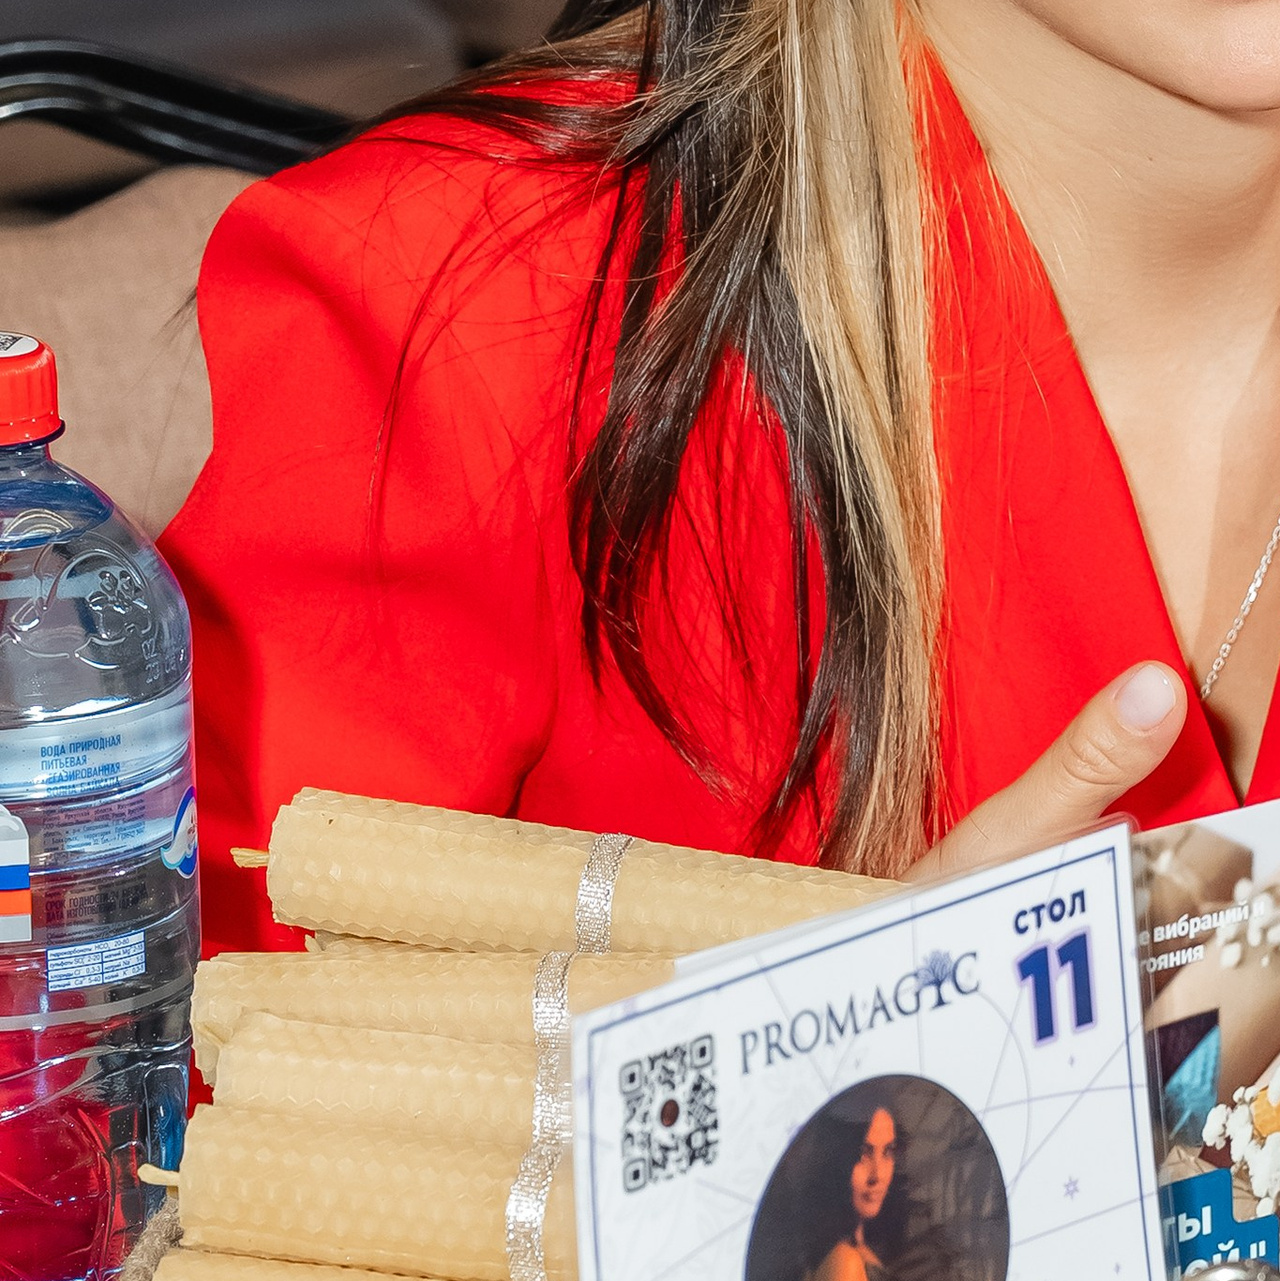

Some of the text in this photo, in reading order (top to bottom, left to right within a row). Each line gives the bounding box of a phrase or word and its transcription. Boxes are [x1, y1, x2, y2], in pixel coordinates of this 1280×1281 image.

[40, 734, 122, 758] ВОДА ПРИРОДНАЯ
[41, 755, 87, 771] ПИТЬЕВАЯ
[45, 762, 121, 785] ЕГАЗИРОВАННАЯ
[1153, 901, 1250, 943] вибраций
[1018, 931, 1095, 1043] 11
